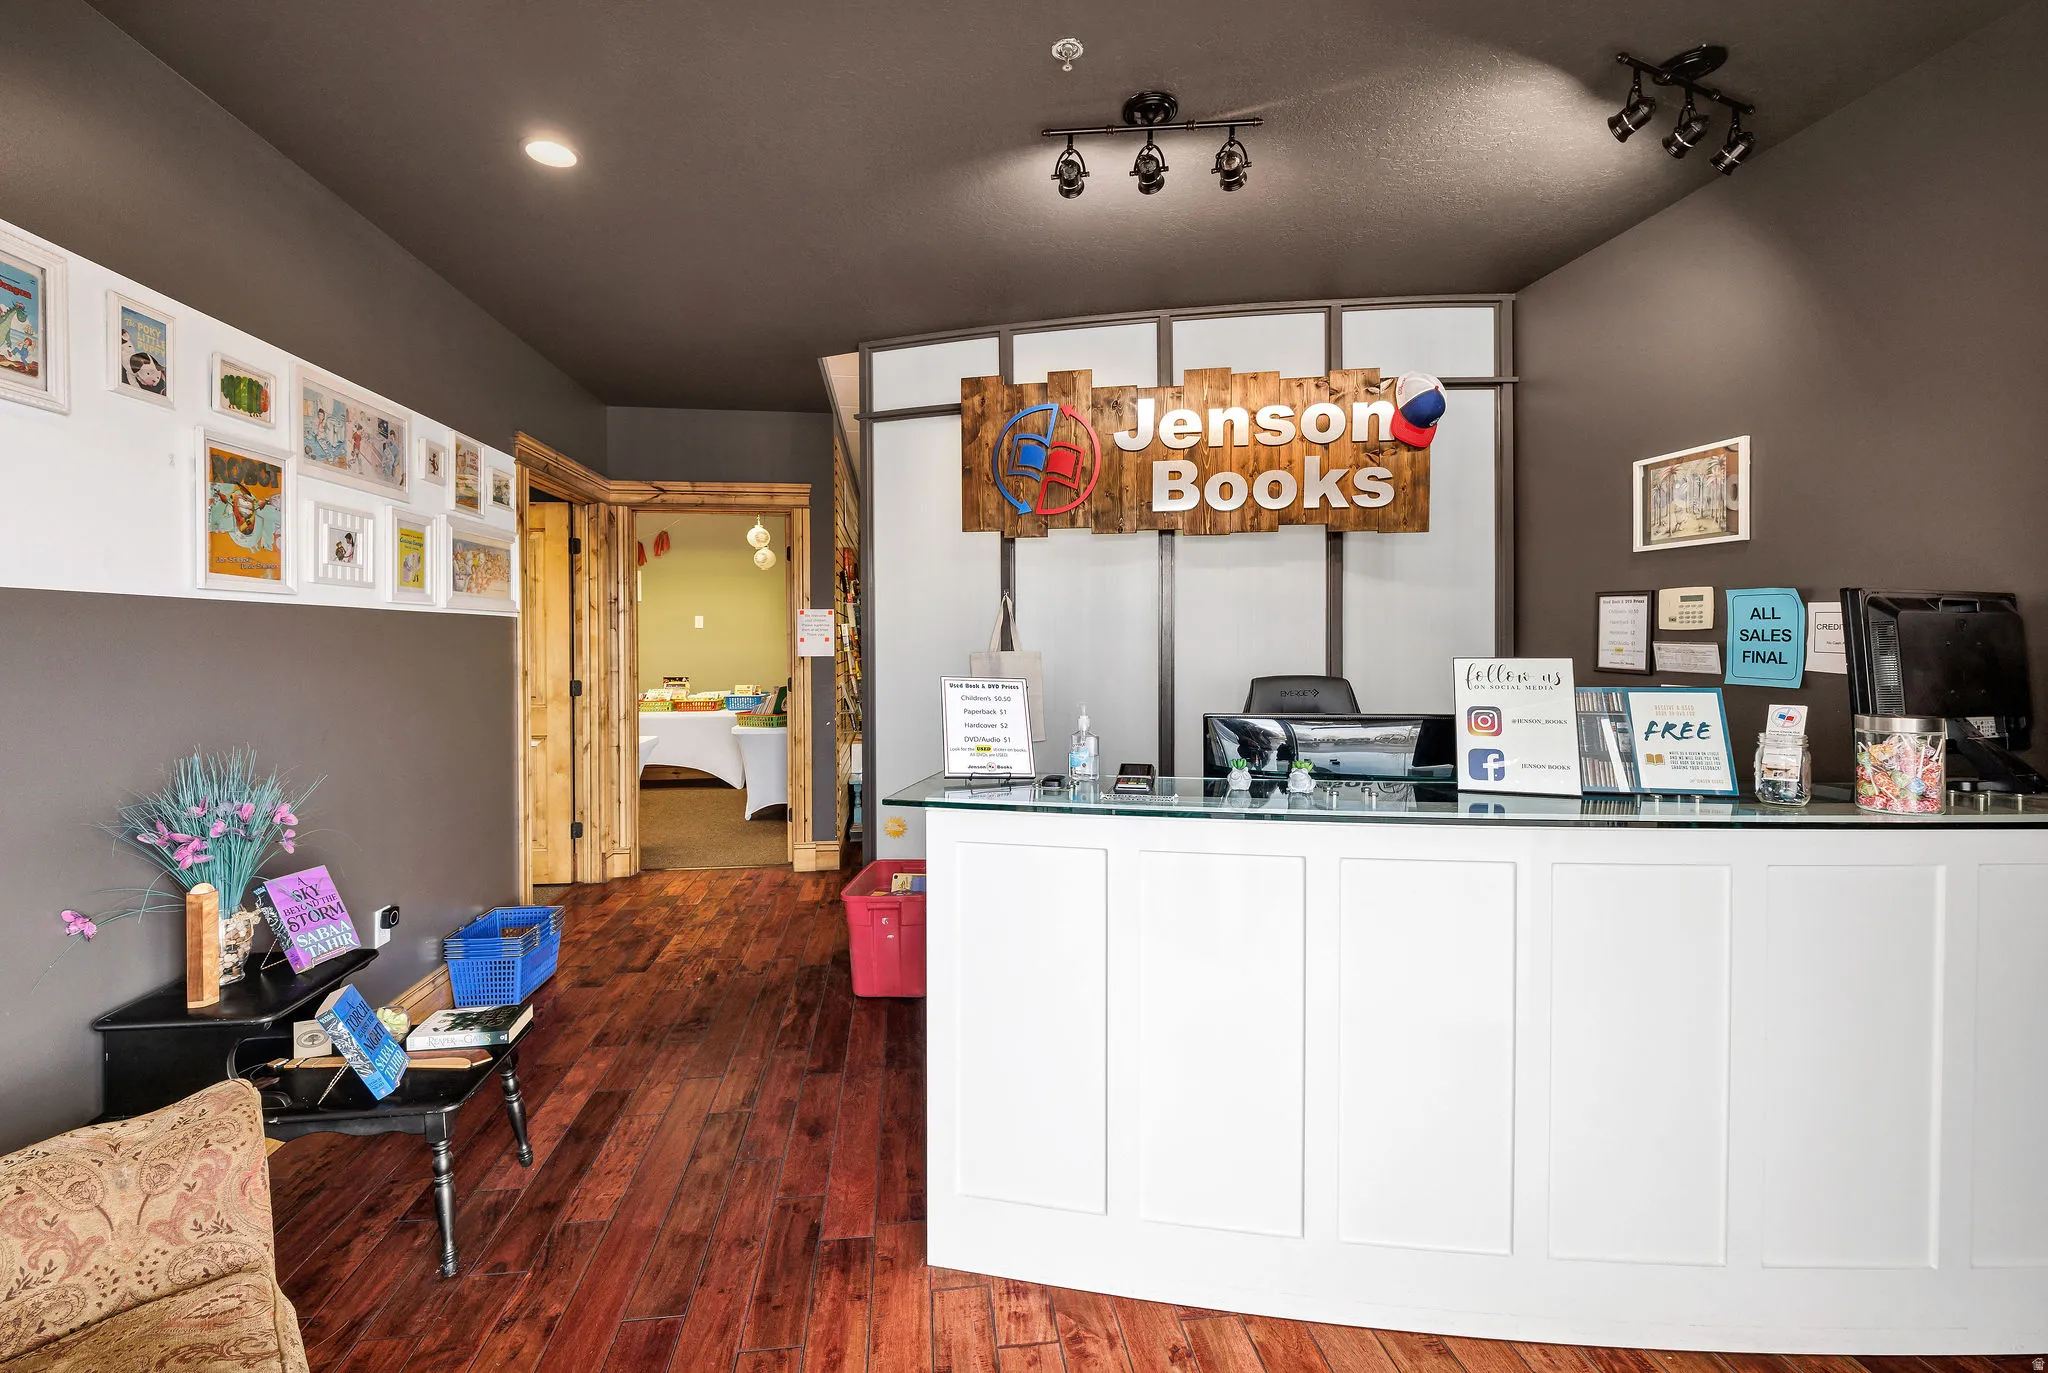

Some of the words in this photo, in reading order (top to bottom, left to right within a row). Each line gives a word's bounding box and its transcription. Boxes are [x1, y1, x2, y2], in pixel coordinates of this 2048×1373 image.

[137, 321, 161, 338] POKY
[1113, 398, 1396, 451] Jenson
[211, 454, 282, 488] ROBOT
[1152, 456, 1395, 512] Books
[1750, 607, 1781, 620] ALL
[1740, 629, 1792, 642] SALES
[1743, 651, 1788, 665] FINAL
[1465, 663, 1534, 690] follow
[1542, 671, 1562, 686] us
[1644, 720, 1712, 741] FREE
[292, 884, 319, 902] SKY
[297, 876, 308, 886] A
[320, 893, 338, 905] THE
[287, 902, 345, 933] STORM
[296, 920, 351, 948] SABAA
[305, 932, 359, 958] TAHIR
[345, 1000, 370, 1032] TORCH
[346, 1001, 356, 1011] A
[363, 1022, 386, 1056] NIGHT
[428, 1036, 456, 1048] REAPER
[374, 1038, 397, 1071] SABAA
[384, 1049, 405, 1080] TAHIR
